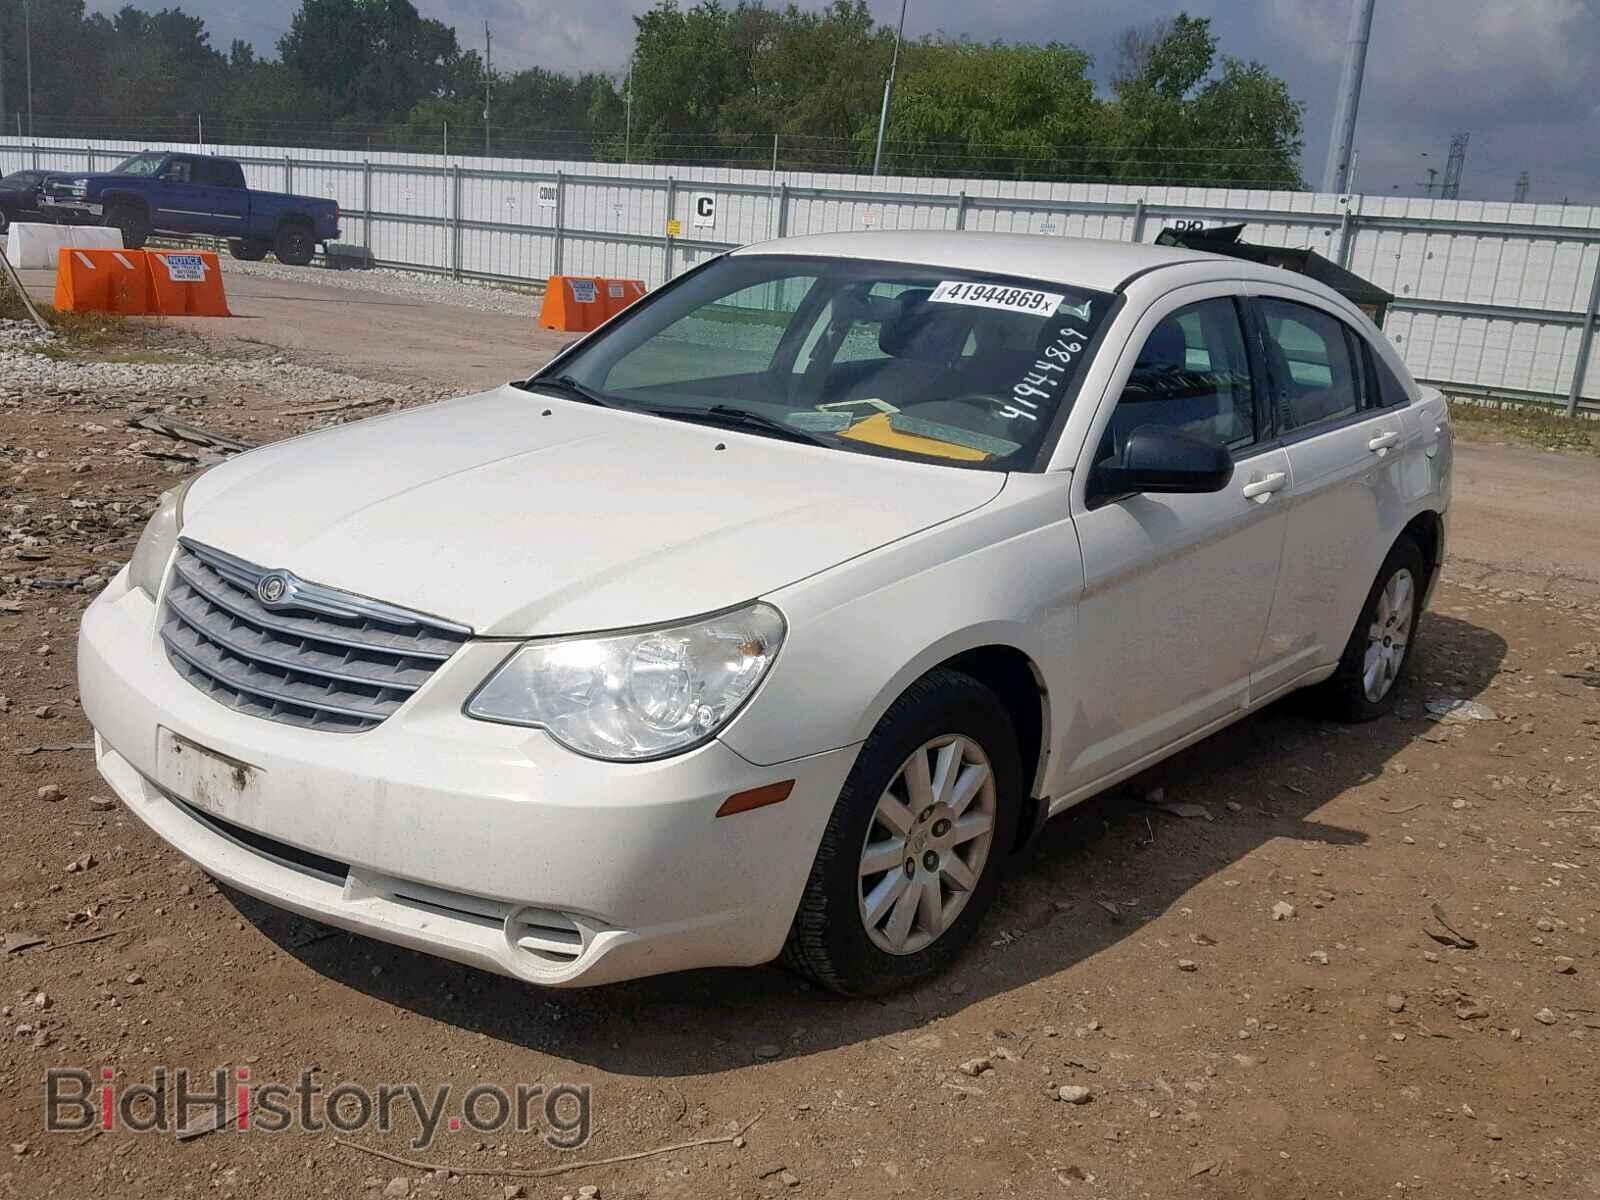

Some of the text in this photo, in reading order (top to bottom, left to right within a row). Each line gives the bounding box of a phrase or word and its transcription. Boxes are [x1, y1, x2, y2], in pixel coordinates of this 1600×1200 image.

[697, 197, 713, 217] C
[168, 256, 201, 264] NOTICE
[947, 283, 1046, 310] 41944869
[999, 328, 1088, 420] 41944869
